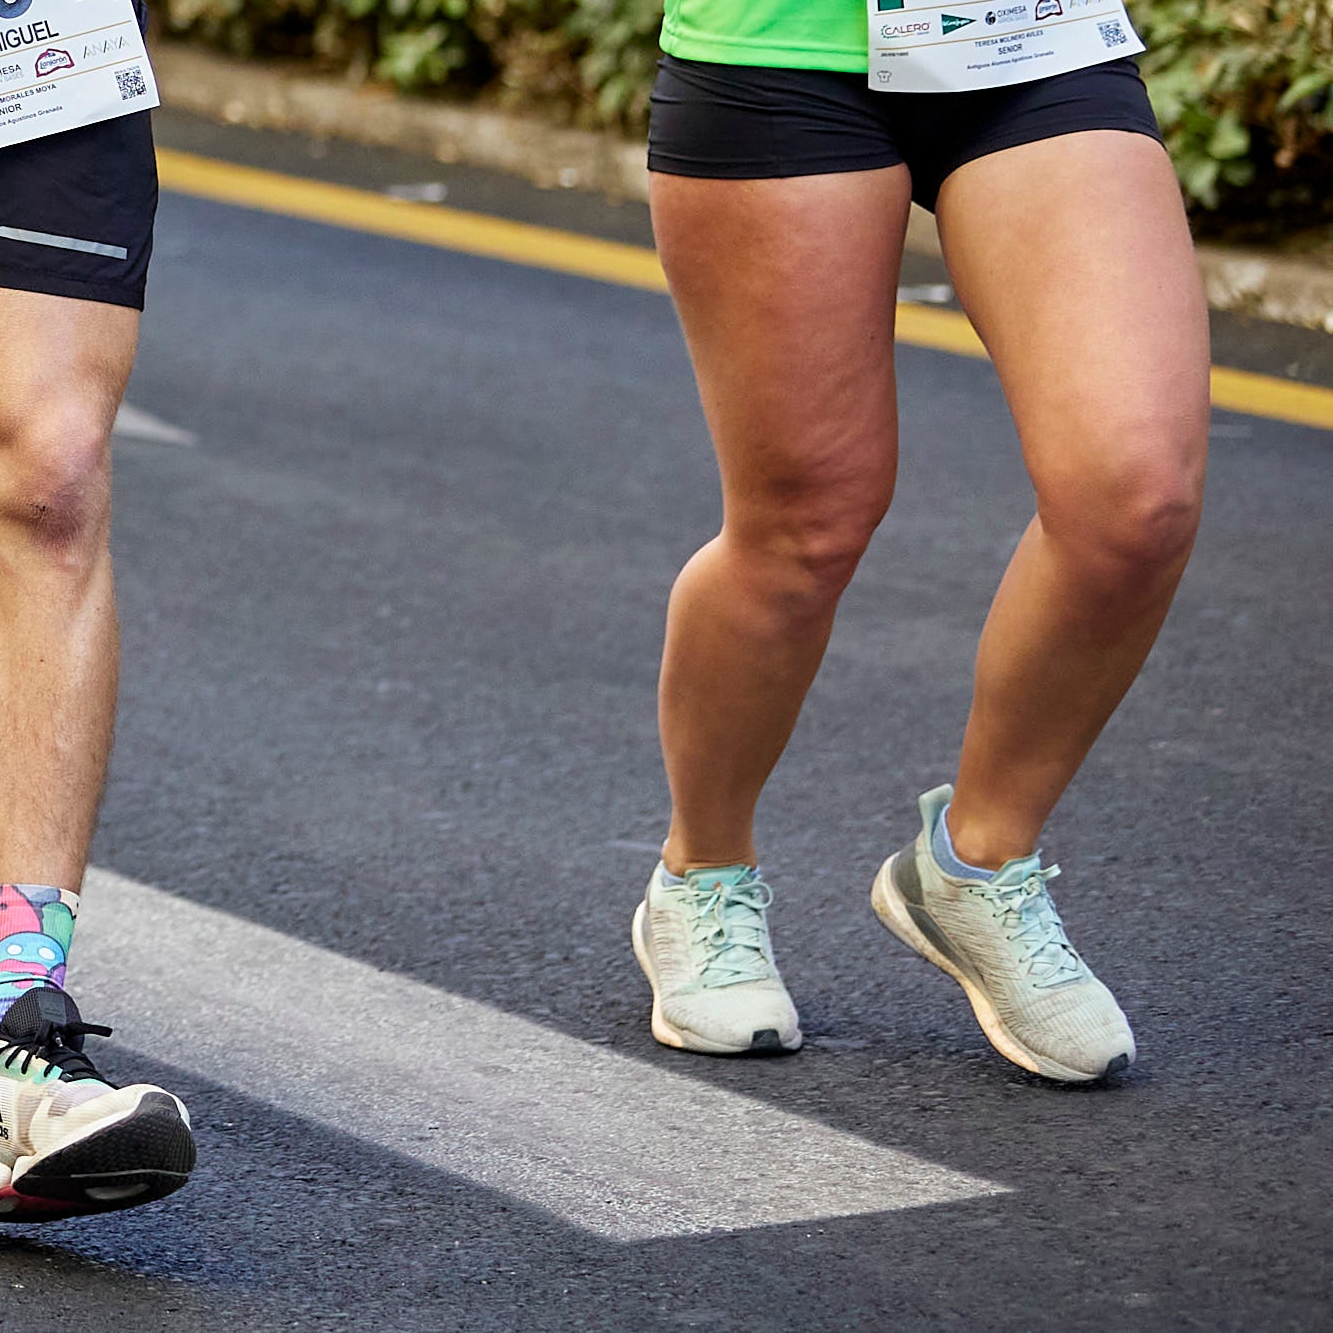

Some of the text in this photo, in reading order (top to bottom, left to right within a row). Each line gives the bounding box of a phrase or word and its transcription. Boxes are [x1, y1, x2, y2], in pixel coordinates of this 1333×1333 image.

[997, 5, 1027, 18] OXIMESA
[884, 22, 930, 36] CALERO
[974, 38, 998, 48] TERESA
[999, 33, 1026, 44] MOLINERO
[998, 43, 1023, 55] SENIOR
[39, 55, 68, 70] Lanjarón
[0, 88, 34, 103] MORALES
[35, 83, 57, 94] MOYA
[37, 105, 63, 116] Granada
